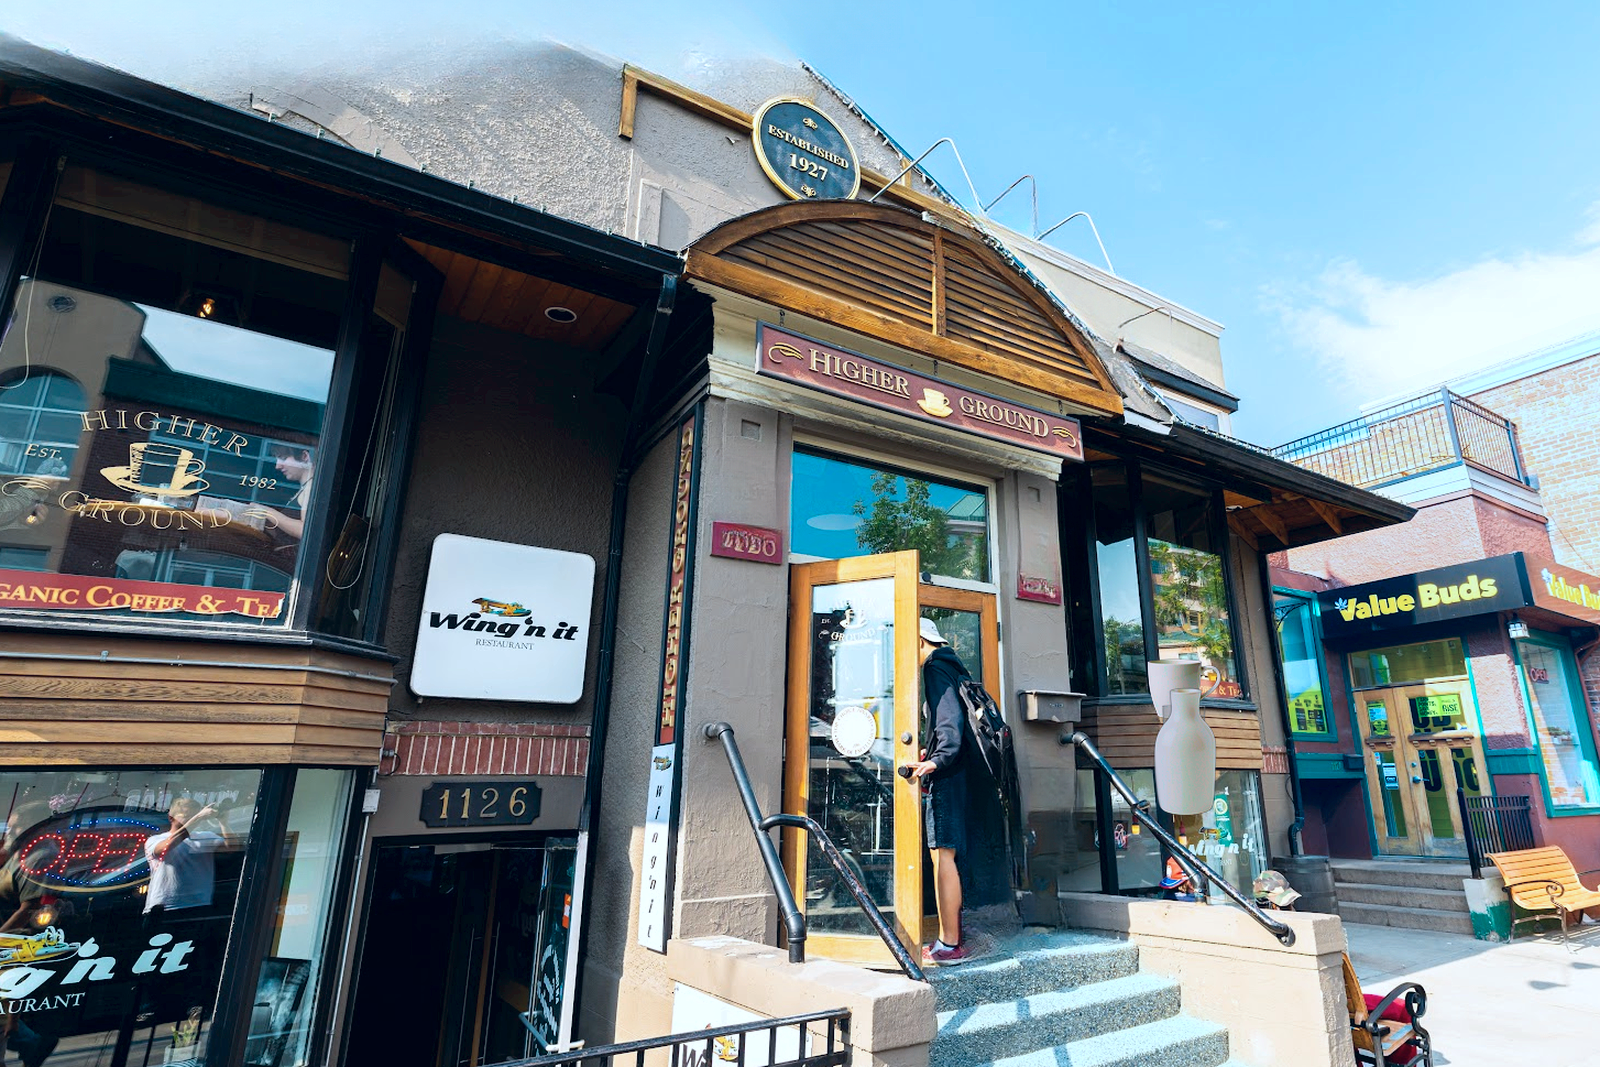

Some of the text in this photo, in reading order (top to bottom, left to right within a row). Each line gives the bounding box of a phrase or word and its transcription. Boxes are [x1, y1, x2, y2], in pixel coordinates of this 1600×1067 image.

[768, 124, 849, 169] ESTABLISHED
[789, 153, 828, 181] 1927
[809, 349, 1049, 438] HIGHER GROUND
[80, 409, 249, 458] HIGHER
[239, 474, 277, 491] 1982
[58, 490, 232, 530] GROUND
[661, 427, 693, 728] HIGHER GROUND
[1545, 573, 1600, 610] Value Bu
[196, 594, 226, 613] &
[1340, 574, 1498, 622] Value Buds
[475, 638, 535, 651] RESTAURANT
[552, 622, 579, 640] it
[439, 786, 528, 819] 1126
[132, 933, 195, 974] it
